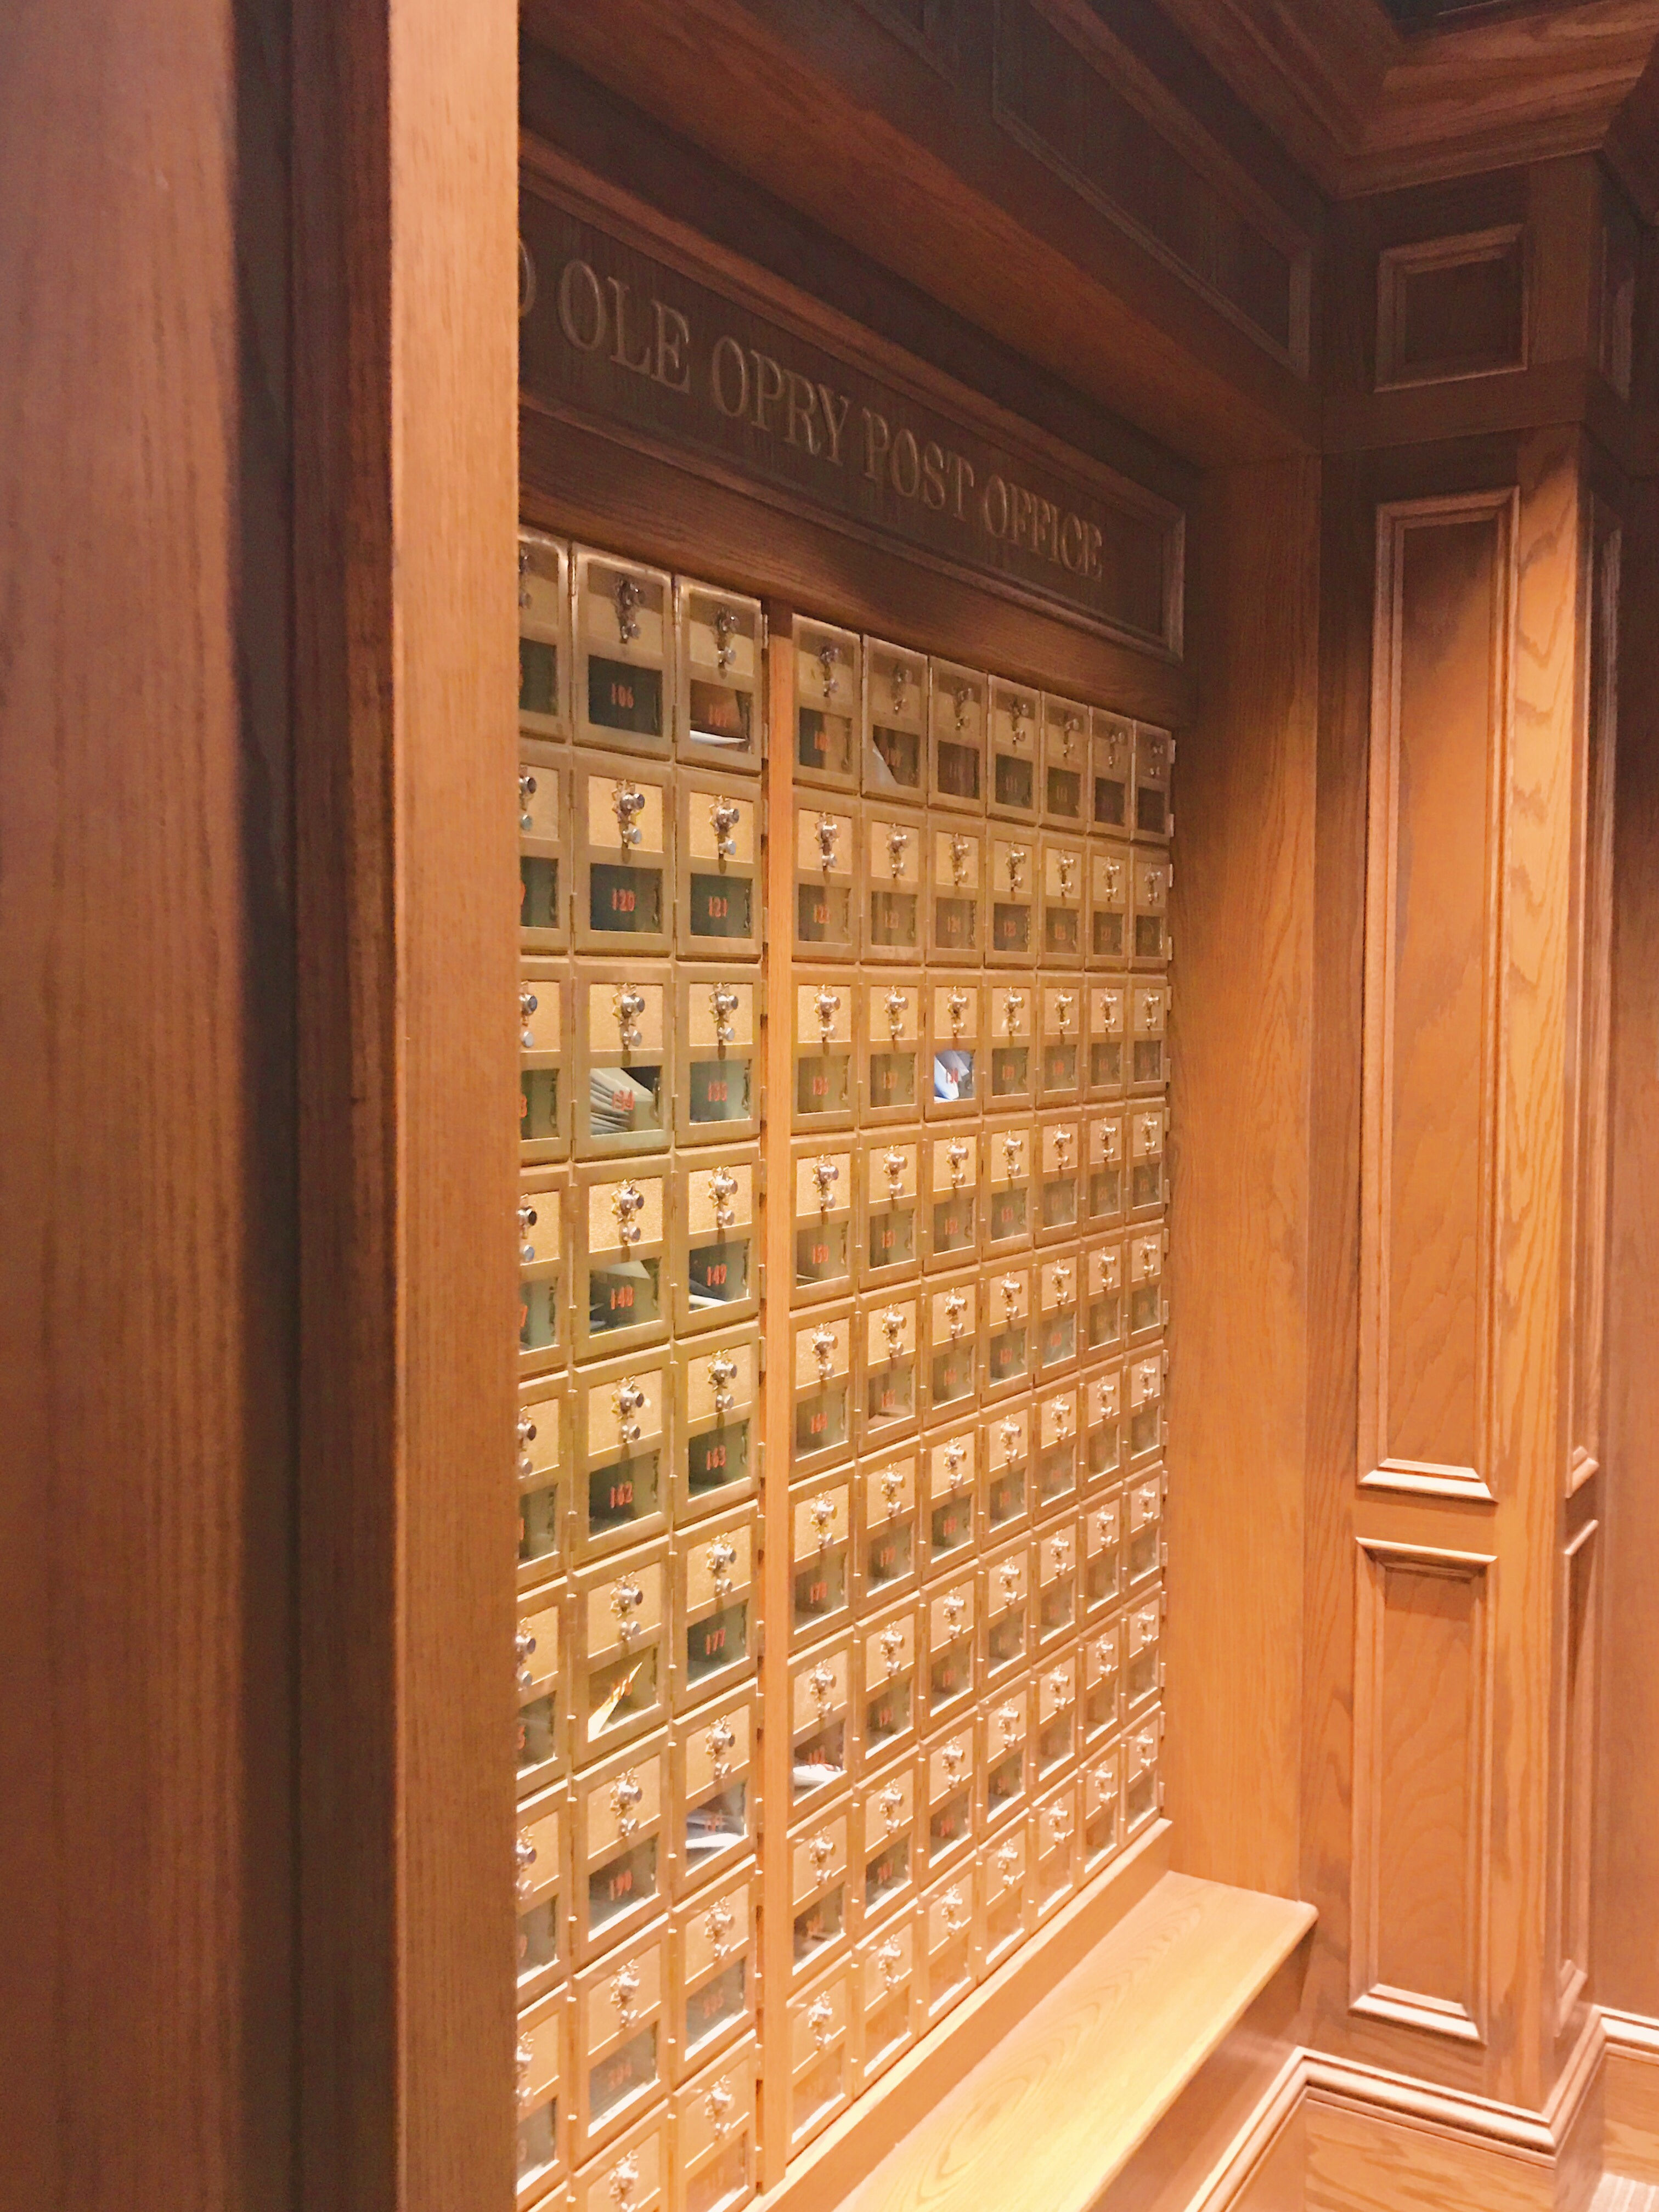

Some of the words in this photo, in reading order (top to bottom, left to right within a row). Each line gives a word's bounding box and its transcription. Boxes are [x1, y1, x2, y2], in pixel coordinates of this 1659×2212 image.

[558, 257, 690, 393] OLE
[711, 335, 851, 466] OPRY
[861, 407, 975, 521] POST
[983, 474, 1103, 582] OFFICE
[611, 682, 634, 709] 106
[611, 888, 635, 912] 120
[708, 895, 728, 917] 121
[707, 1263, 727, 1286] 149
[706, 1444, 726, 1471] 163
[610, 1480, 633, 1509] 162
[706, 1628, 726, 1655] 177
